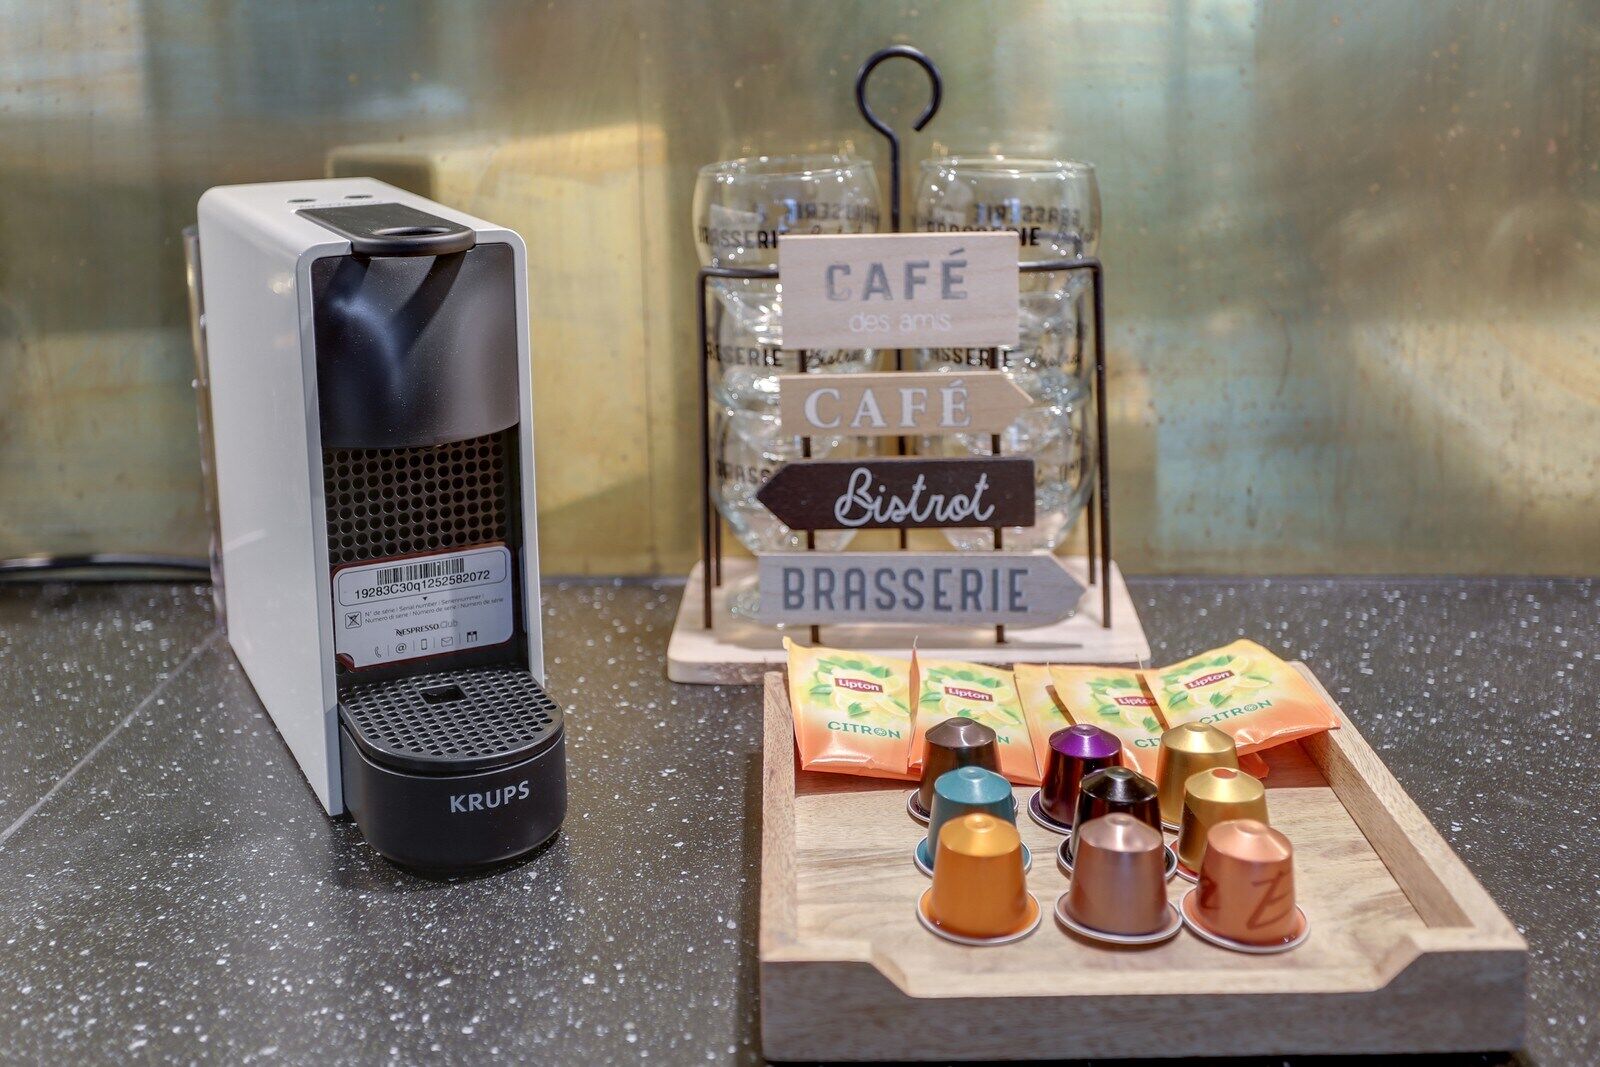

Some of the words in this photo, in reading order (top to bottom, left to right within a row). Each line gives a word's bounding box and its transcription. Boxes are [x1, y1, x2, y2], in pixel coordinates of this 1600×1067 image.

[825, 247, 968, 301] CAFÉ
[850, 310, 890, 333] des
[804, 378, 972, 429] CAFÉ
[834, 466, 995, 527] Bistrot
[354, 569, 491, 600] 19283C30q1252582072
[783, 566, 1029, 613] BRASSERIE
[416, 601, 438, 609] number
[395, 623, 439, 637] NESPRESSO
[440, 619, 458, 629] Club
[838, 679, 880, 692] Lipton
[1189, 671, 1230, 688] Lipton
[949, 687, 990, 701] Lipton
[1199, 700, 1273, 724] CITRON
[828, 720, 901, 739] CITRON
[450, 780, 530, 813] KRUPS
